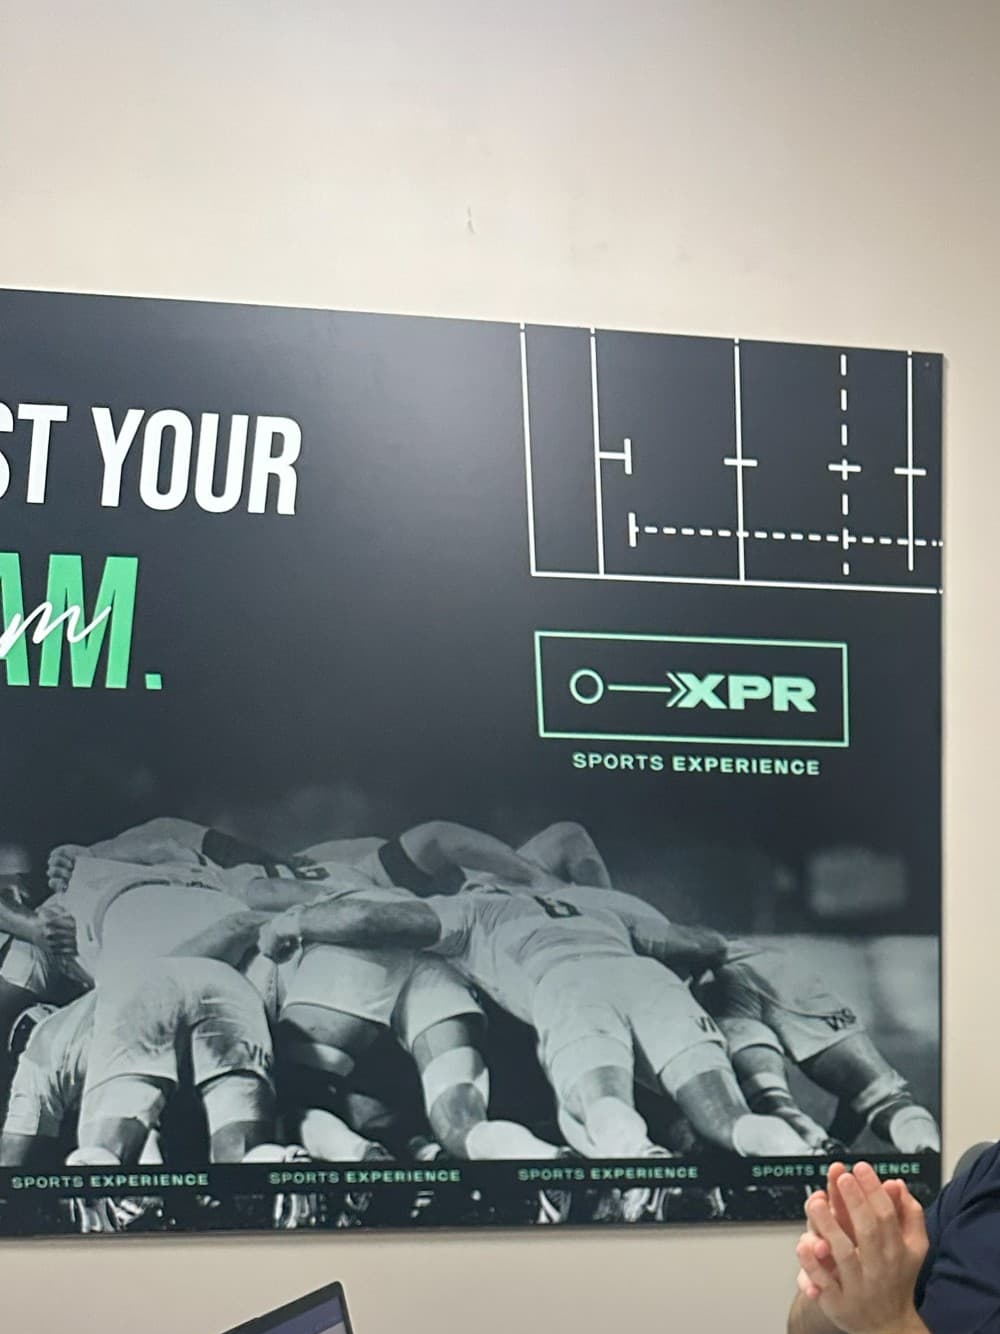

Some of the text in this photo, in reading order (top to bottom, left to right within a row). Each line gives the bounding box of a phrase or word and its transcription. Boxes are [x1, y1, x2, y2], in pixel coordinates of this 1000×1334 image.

[91, 406, 303, 515] YOUR
[675, 671, 817, 713] XPR
[572, 752, 821, 776] SPORTS EXPERIENCE
[269, 1169, 461, 1185] SPORTS EXPERIENCE
[518, 1166, 698, 1181] SPORTS EXPERIENCE
[752, 1164, 814, 1177] SPORTS
[11, 1173, 209, 1189] SPORTS EXPERIENCE
